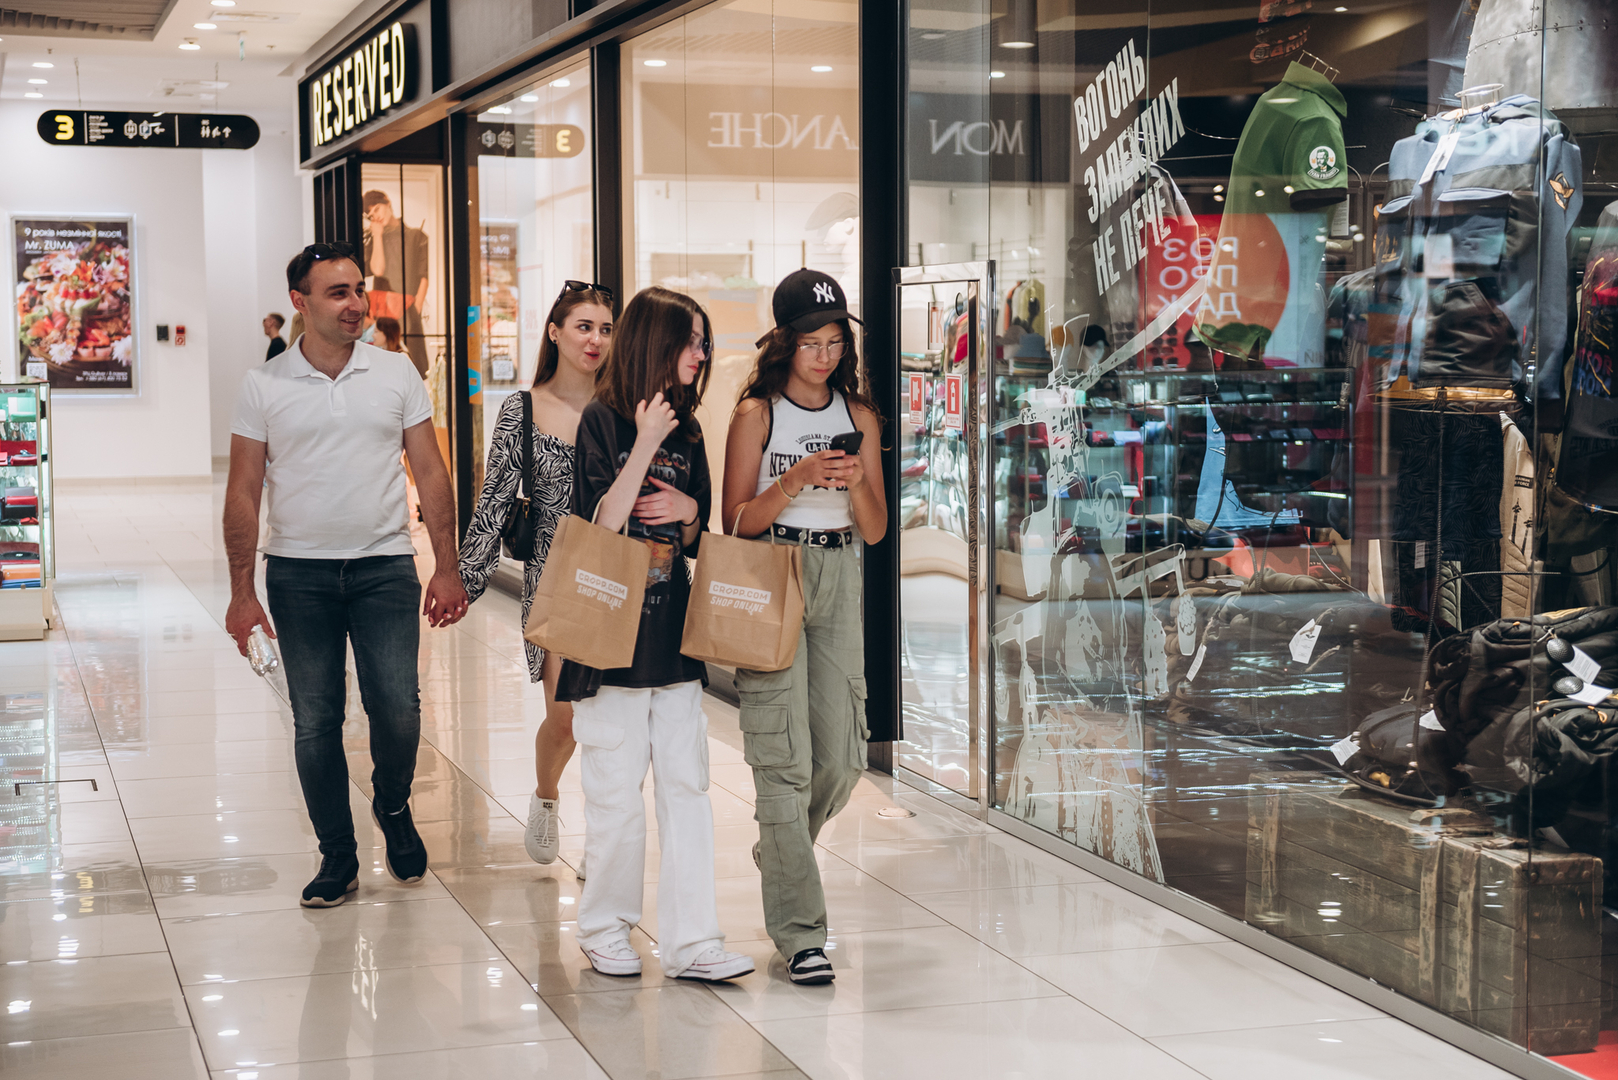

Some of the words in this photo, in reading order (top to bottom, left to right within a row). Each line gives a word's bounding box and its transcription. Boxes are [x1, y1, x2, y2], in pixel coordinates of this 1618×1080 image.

[313, 21, 405, 147] RESERVED
[1074, 37, 1146, 155] ВОГОНЬ
[54, 114, 75, 141] 3
[1084, 77, 1186, 224] ЗАПЕКЛИХ
[24, 227, 32, 237] 9
[1092, 224, 1121, 297] НЕ
[1119, 177, 1172, 272] ПЕЧЕ
[25, 240, 42, 250] Mr.
[43, 240, 75, 250] ZUMA
[812, 281, 836, 304] NY
[578, 572, 626, 596] CROPP.COM
[712, 584, 768, 601] CROPP.COM
[576, 584, 598, 598] SHOP
[596, 591, 624, 609] ONLINE
[710, 595, 733, 607] SHOP
[733, 600, 765, 613] ONLINE
